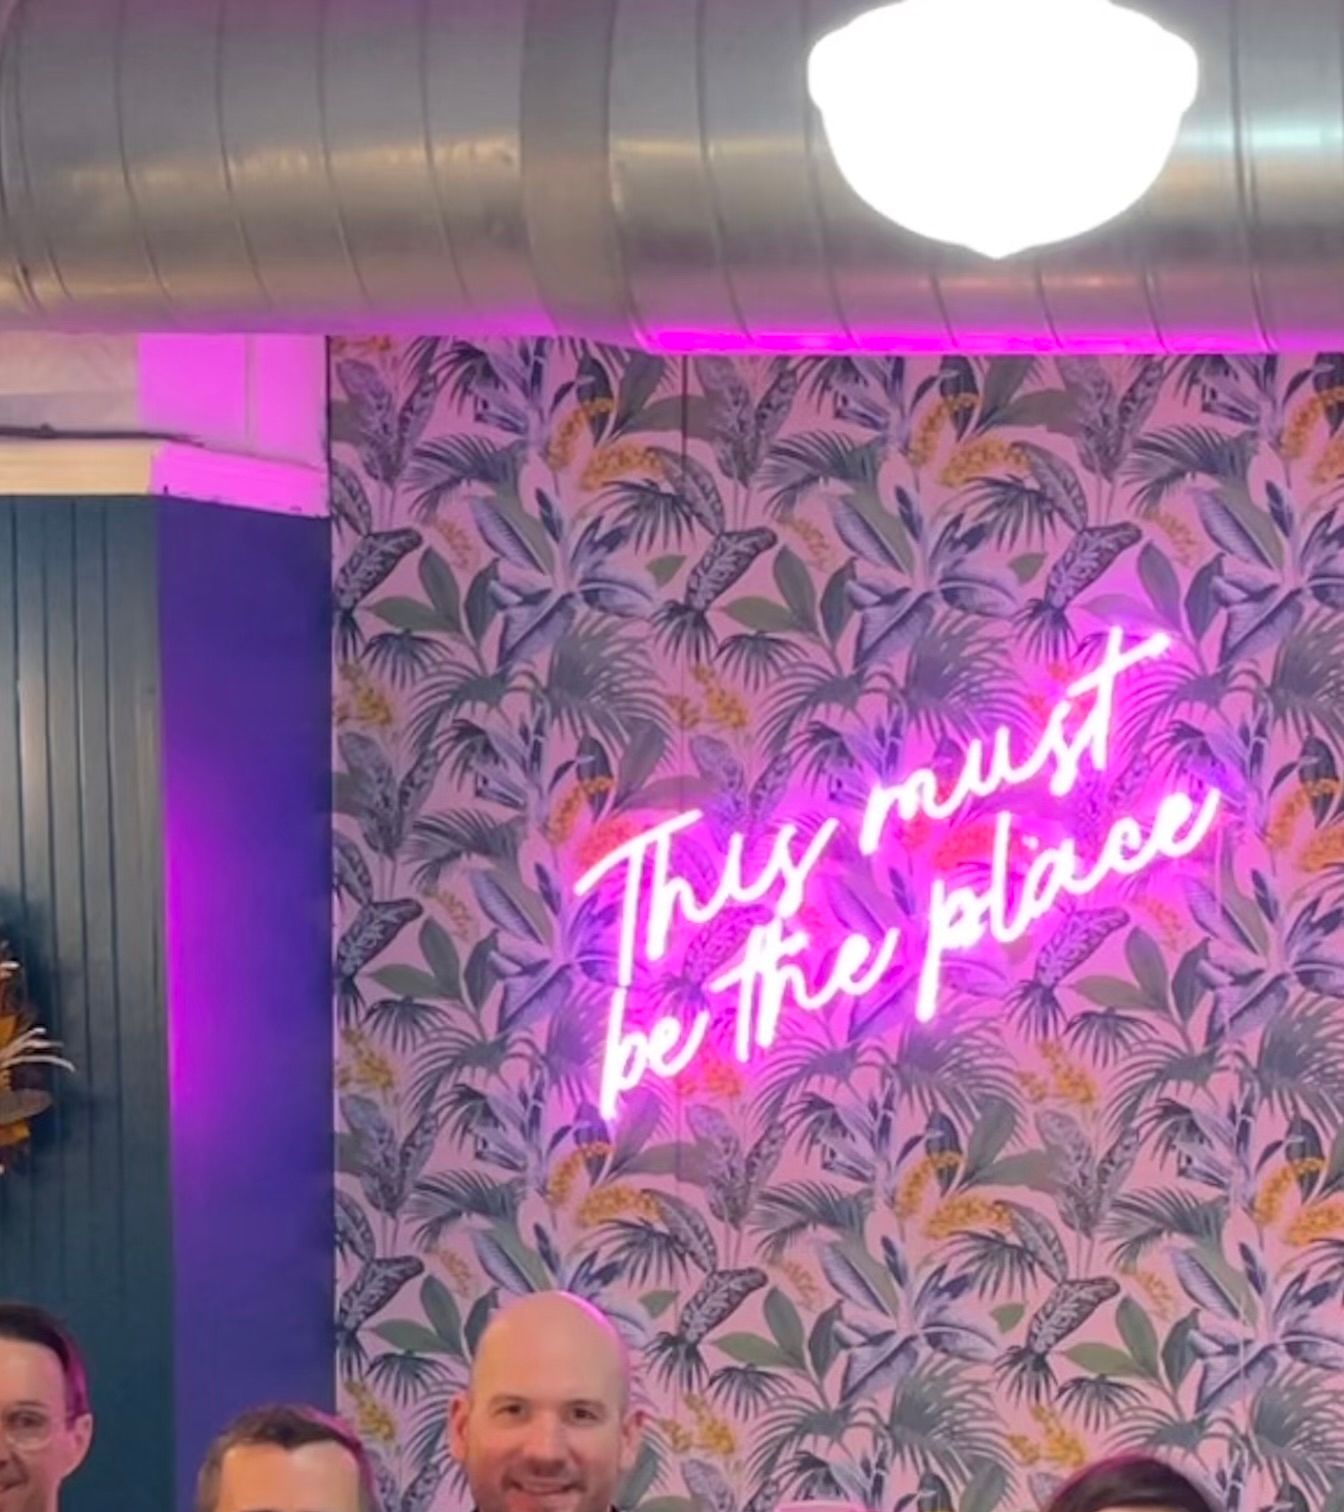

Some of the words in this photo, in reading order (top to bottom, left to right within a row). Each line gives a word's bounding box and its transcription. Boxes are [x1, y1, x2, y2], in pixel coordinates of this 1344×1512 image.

[573, 808, 840, 987] This
[860, 625, 1171, 856] must
[598, 985, 711, 1122] be
[711, 915, 901, 1063] the
[913, 787, 1221, 1023] place
